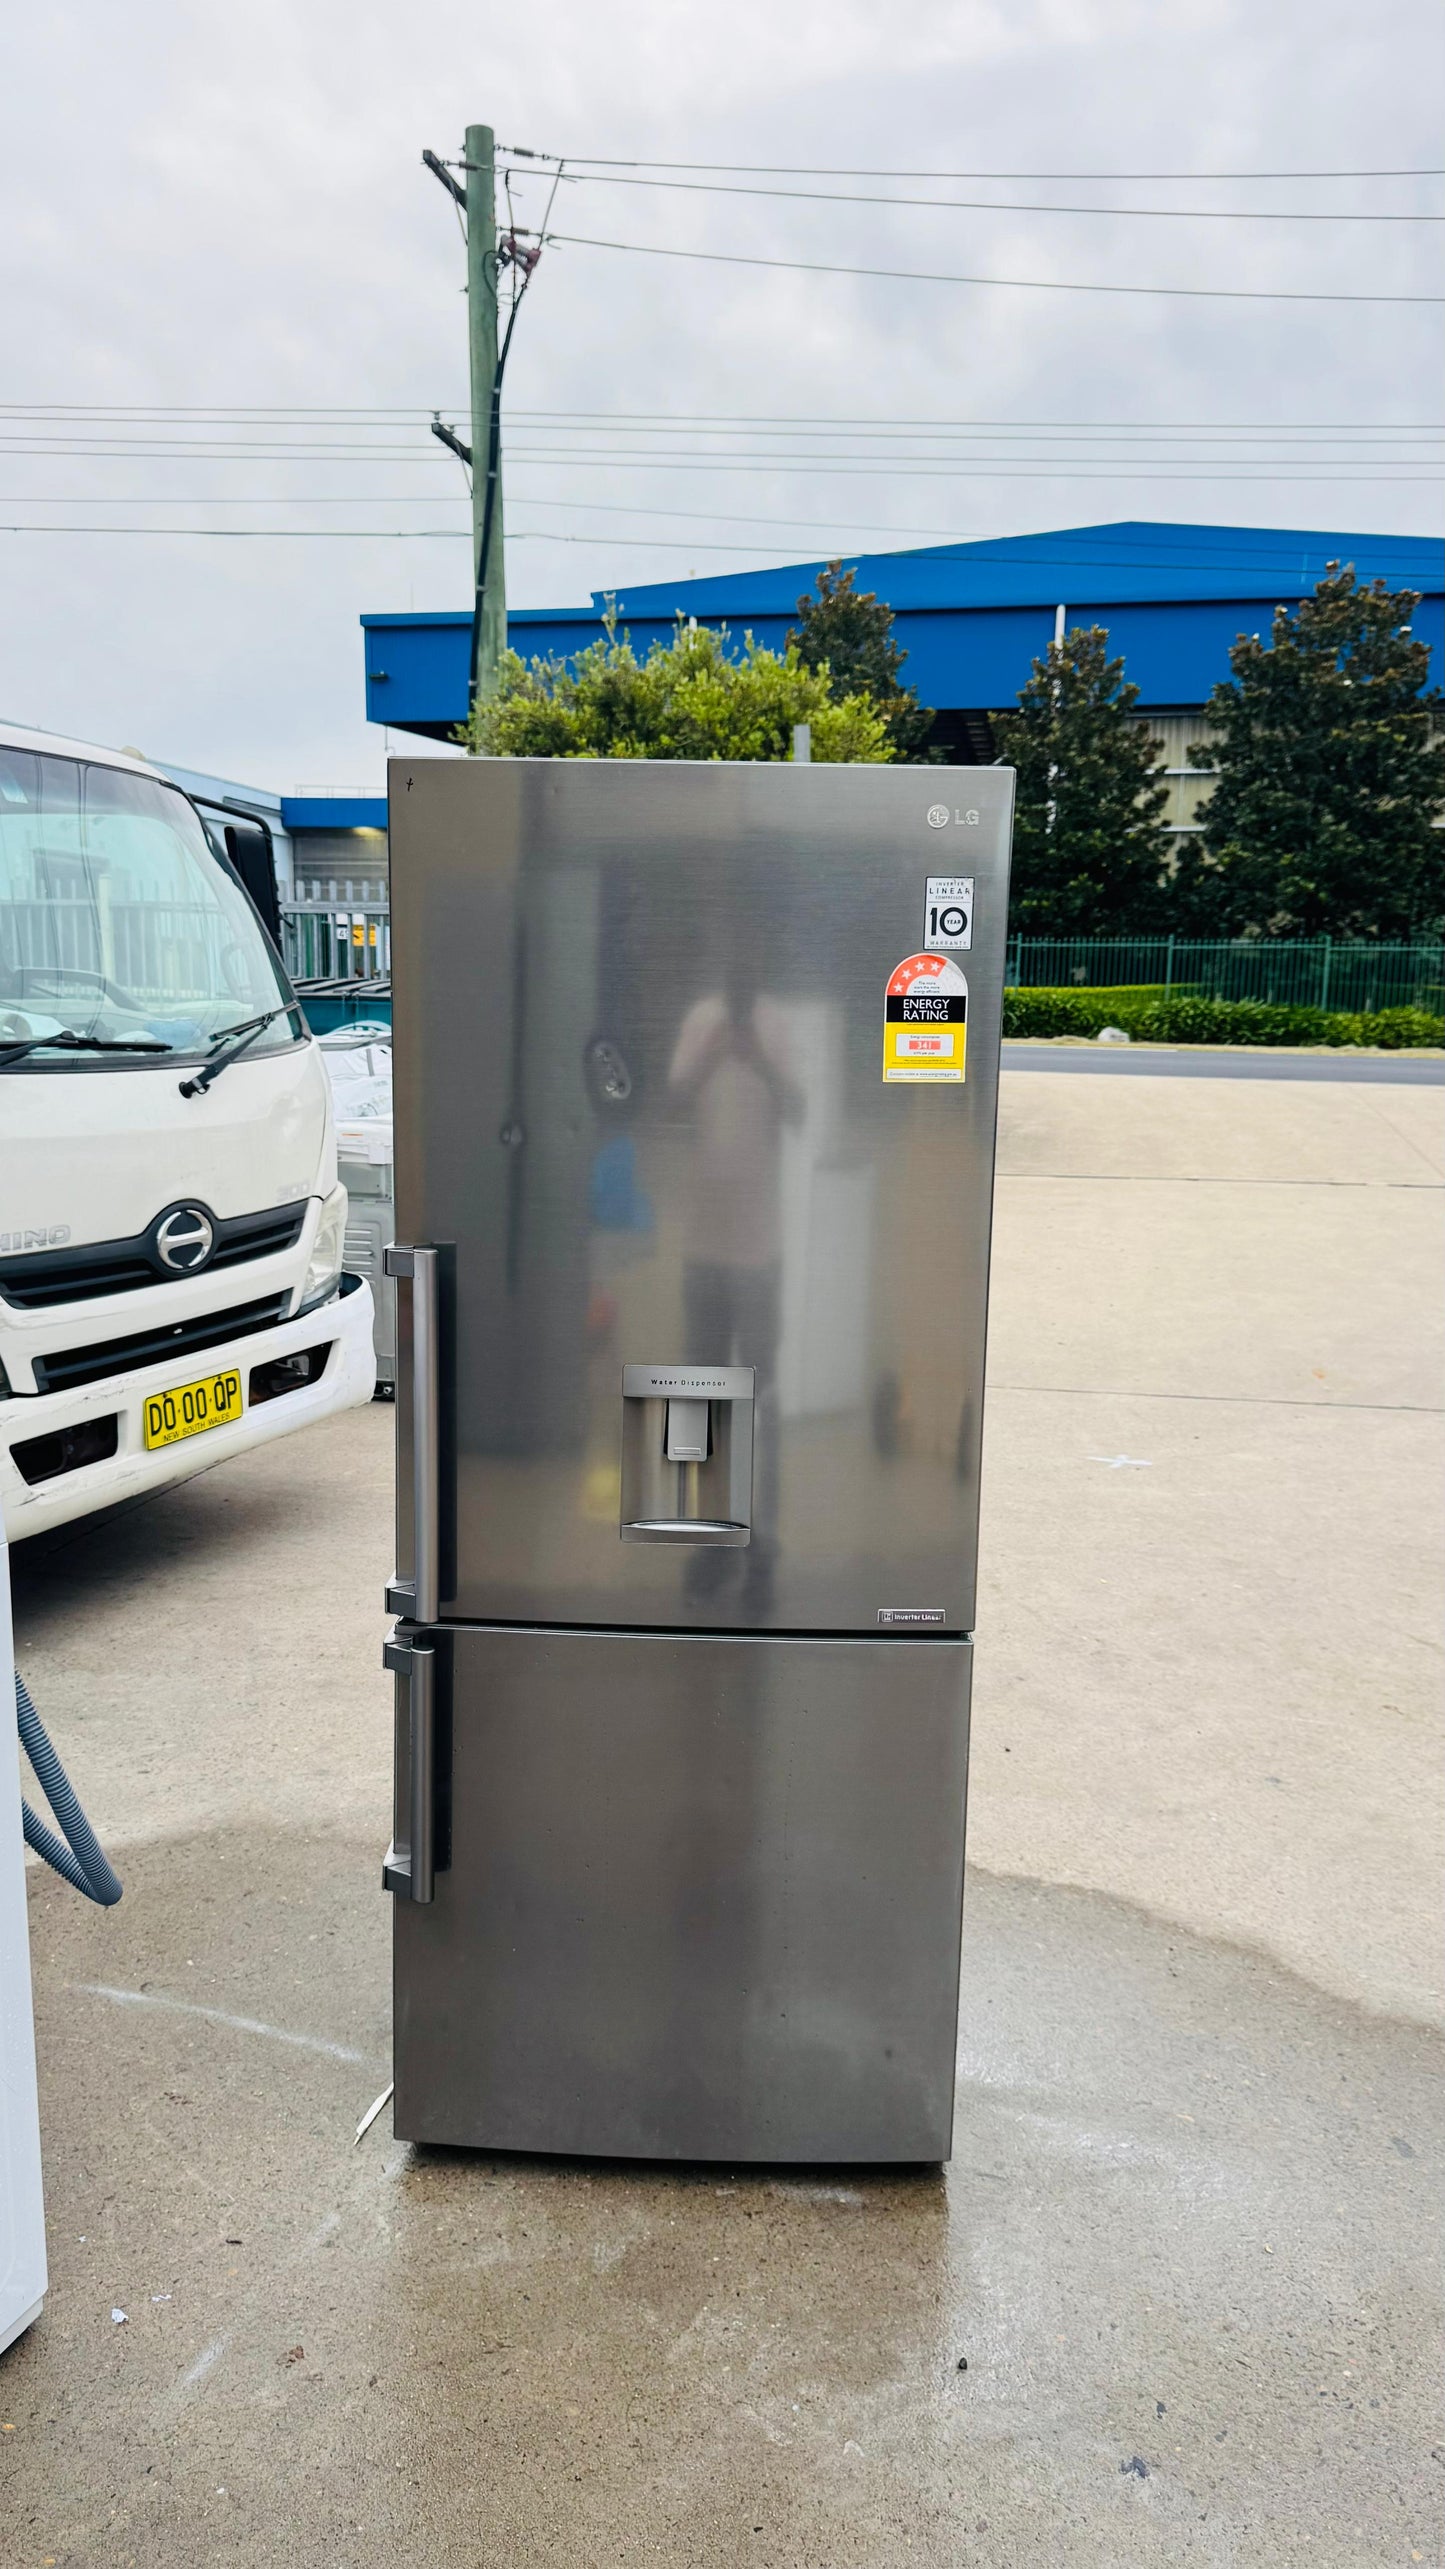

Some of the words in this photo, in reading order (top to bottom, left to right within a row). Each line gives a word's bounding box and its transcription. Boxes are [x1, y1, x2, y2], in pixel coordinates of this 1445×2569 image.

[954, 809, 979, 825] LG
[930, 907, 967, 937] 10
[903, 998, 950, 1009] ENERGY
[903, 1010, 949, 1020] RATING
[681, 1379, 726, 1387] Dispenser
[163, 1431, 180, 1442] NEW
[182, 1423, 206, 1436] SOUTH
[208, 1412, 231, 1425] WALES
